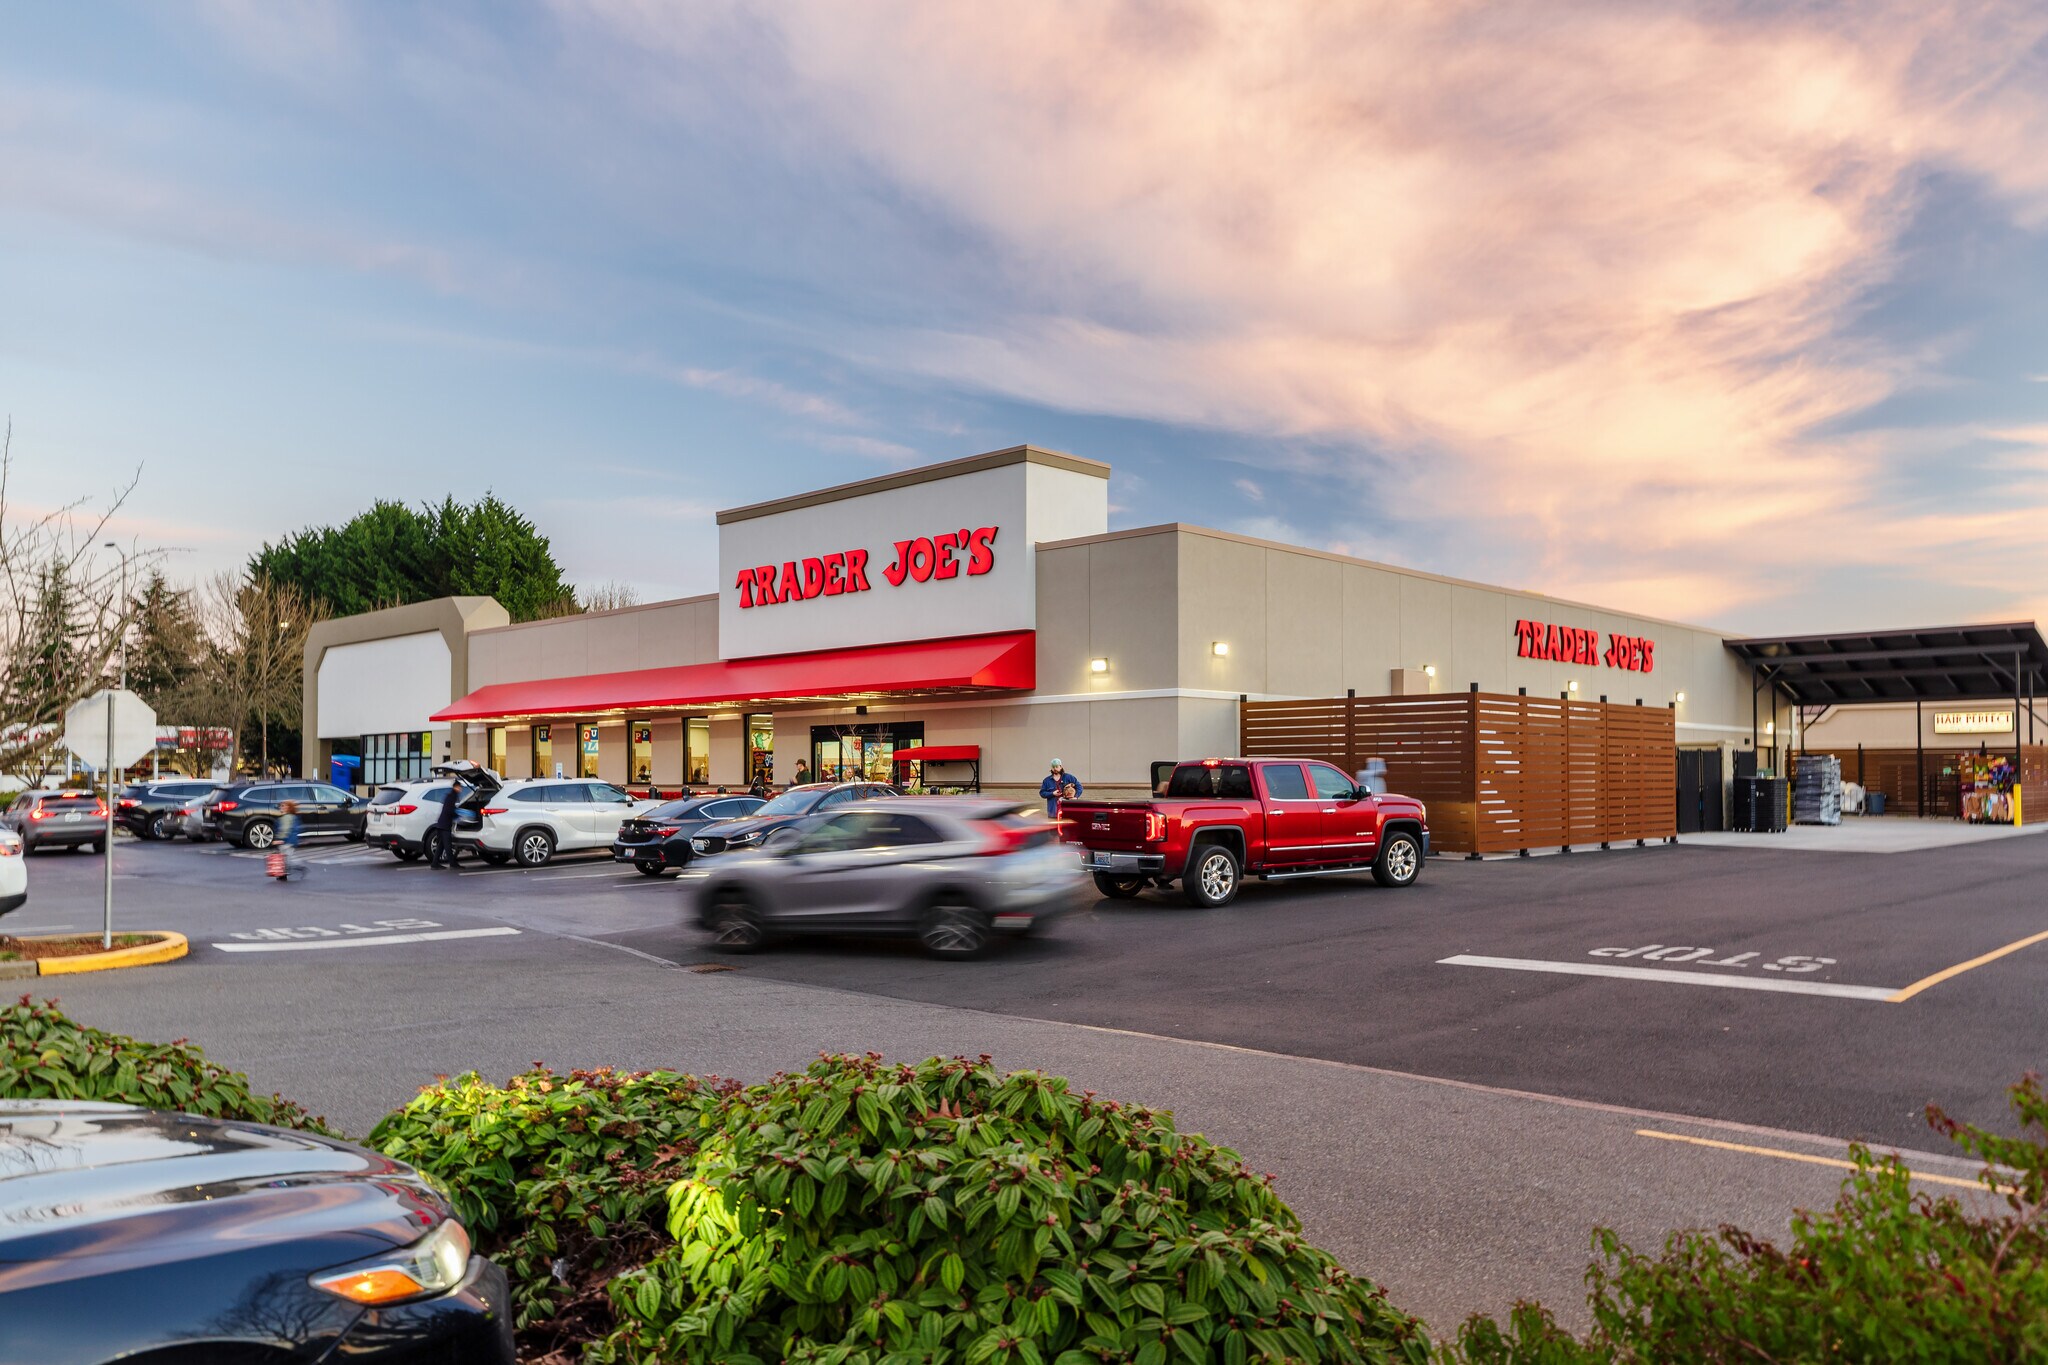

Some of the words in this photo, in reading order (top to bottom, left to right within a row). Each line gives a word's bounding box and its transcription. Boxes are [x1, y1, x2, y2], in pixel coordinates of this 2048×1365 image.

[735, 549, 871, 608] TRADER
[882, 526, 999, 587] JOE'S
[1514, 619, 1599, 666] TRADER
[1604, 633, 1655, 673] JOE'S
[1936, 713, 1962, 724] HAIR
[1588, 944, 1837, 973] STOP
